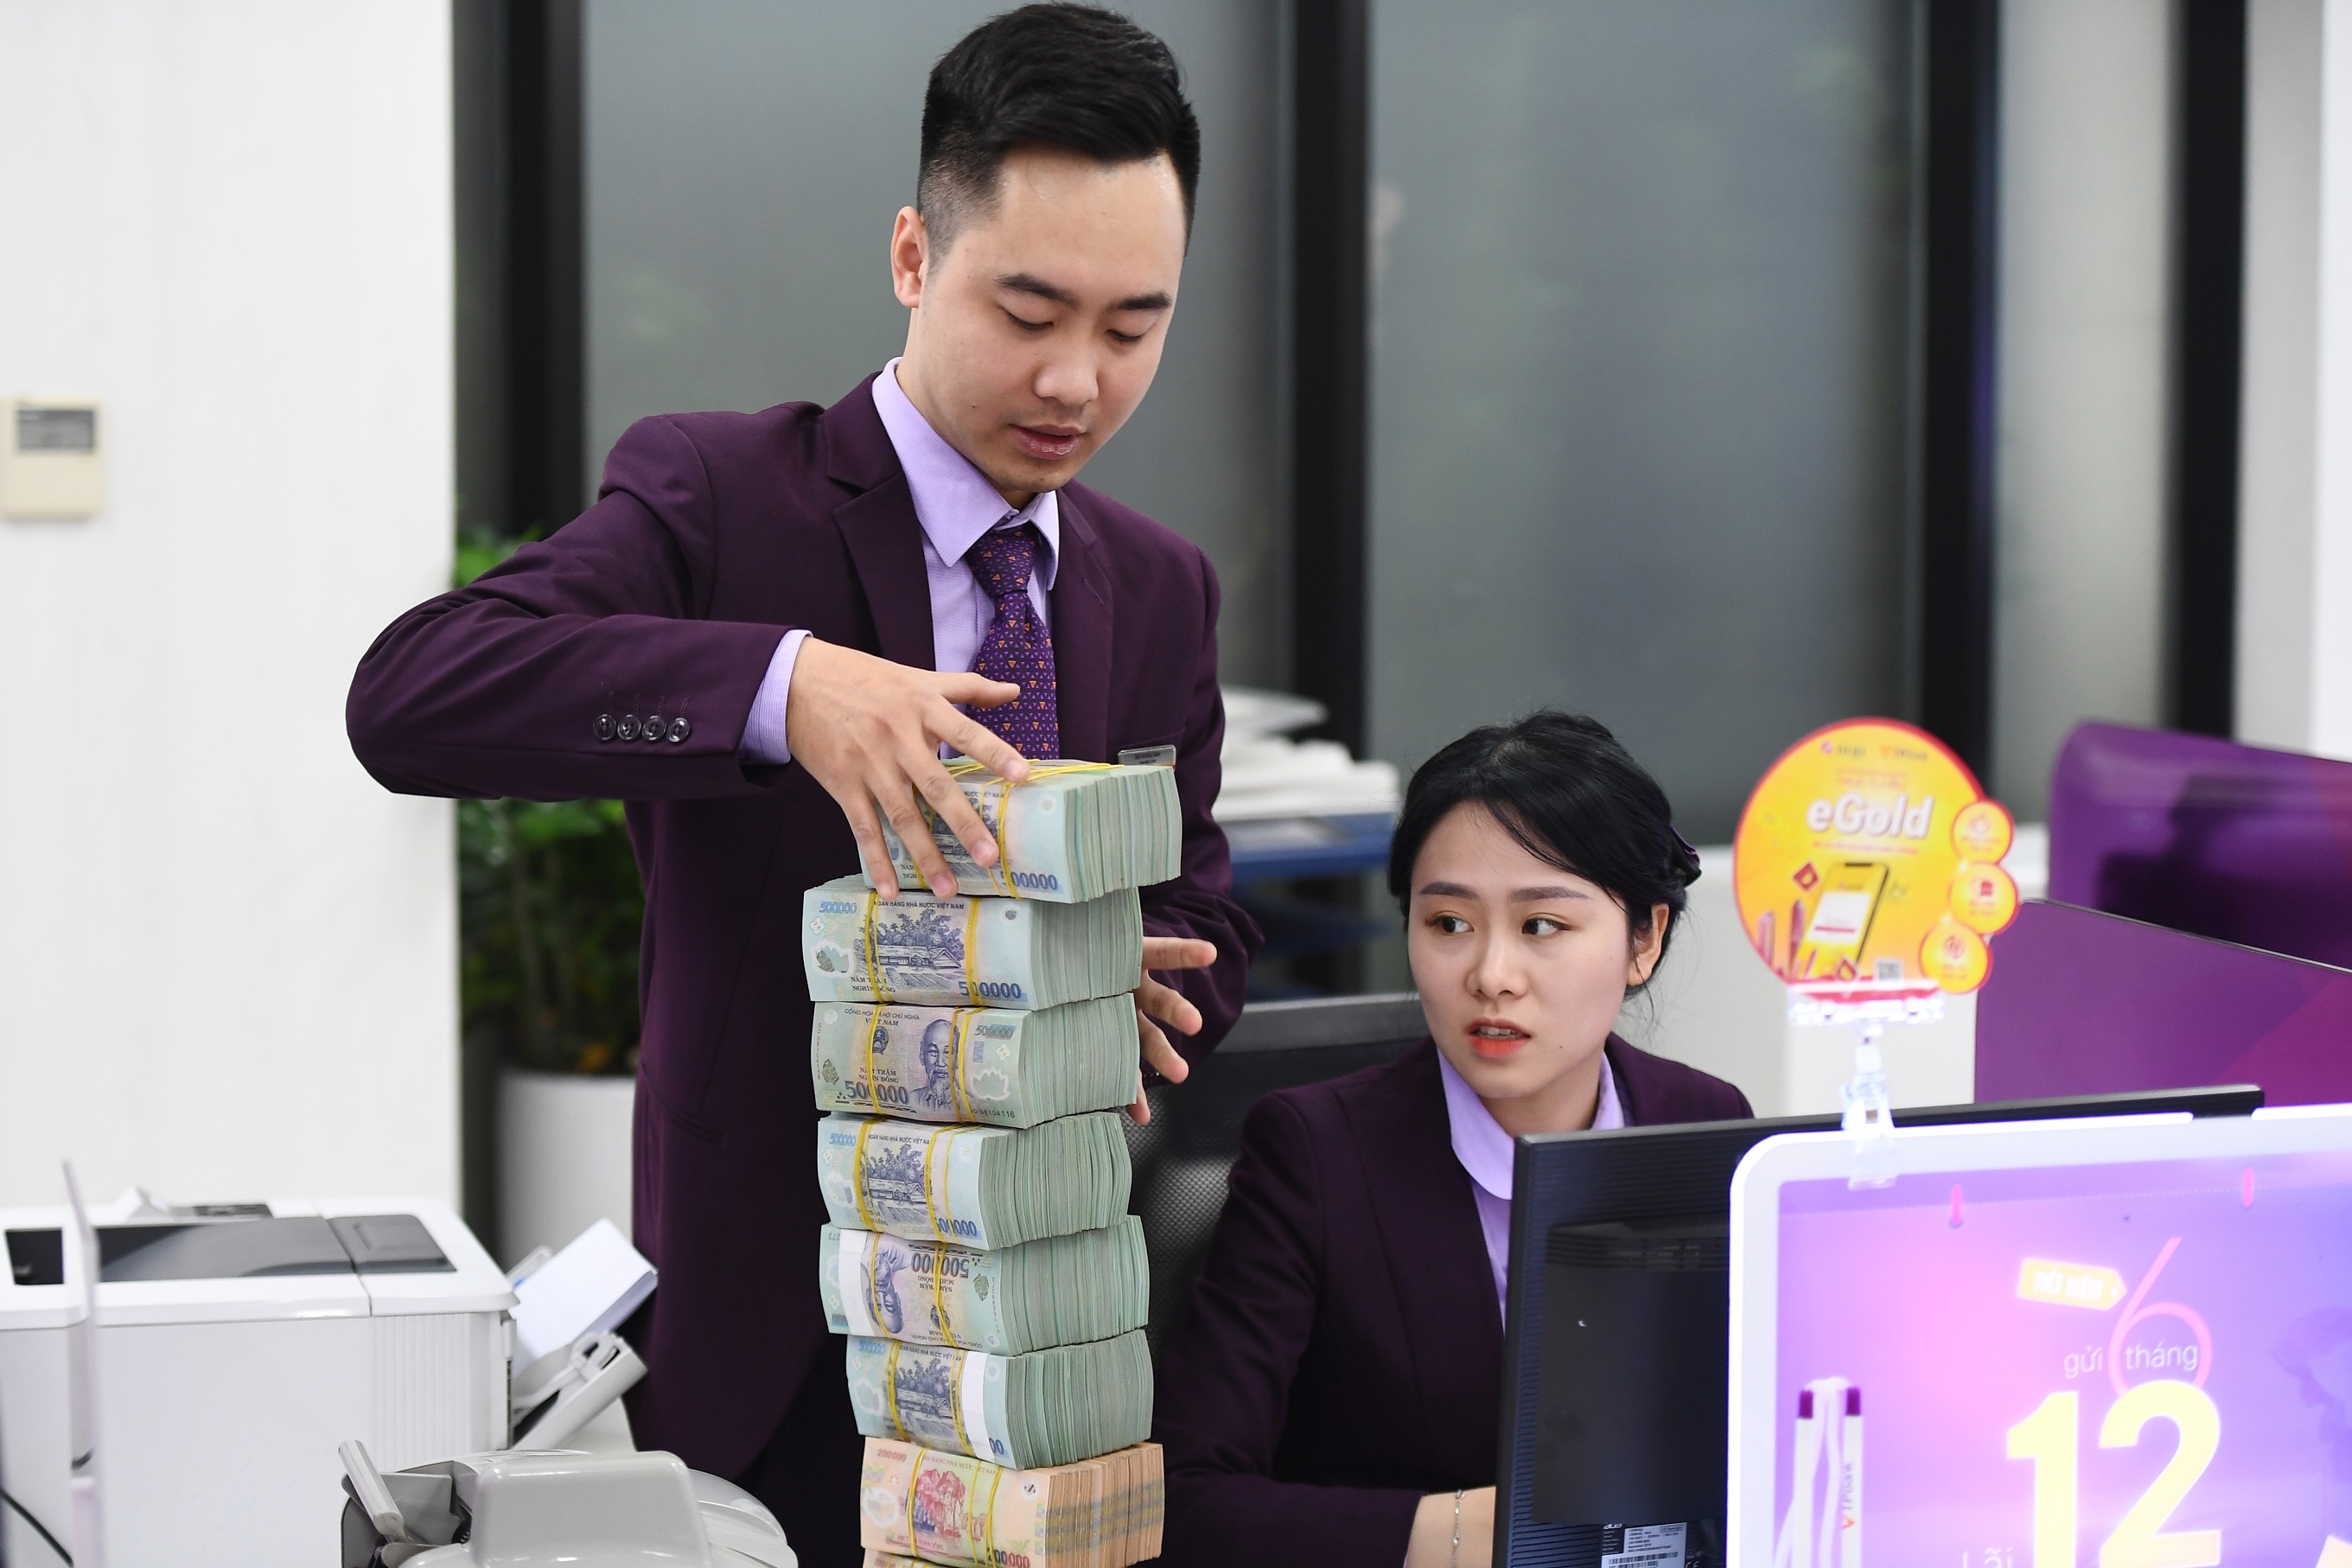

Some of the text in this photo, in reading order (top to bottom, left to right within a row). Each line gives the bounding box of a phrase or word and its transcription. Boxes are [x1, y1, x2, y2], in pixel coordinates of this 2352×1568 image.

[1807, 792, 1935, 839] eGold
[819, 901, 857, 914] 500000
[2063, 1345, 2103, 1379] gửi
[2125, 1341, 2199, 1371] tháng
[877, 1450, 907, 1462] 200000
[2006, 1379, 2221, 1568] 12
